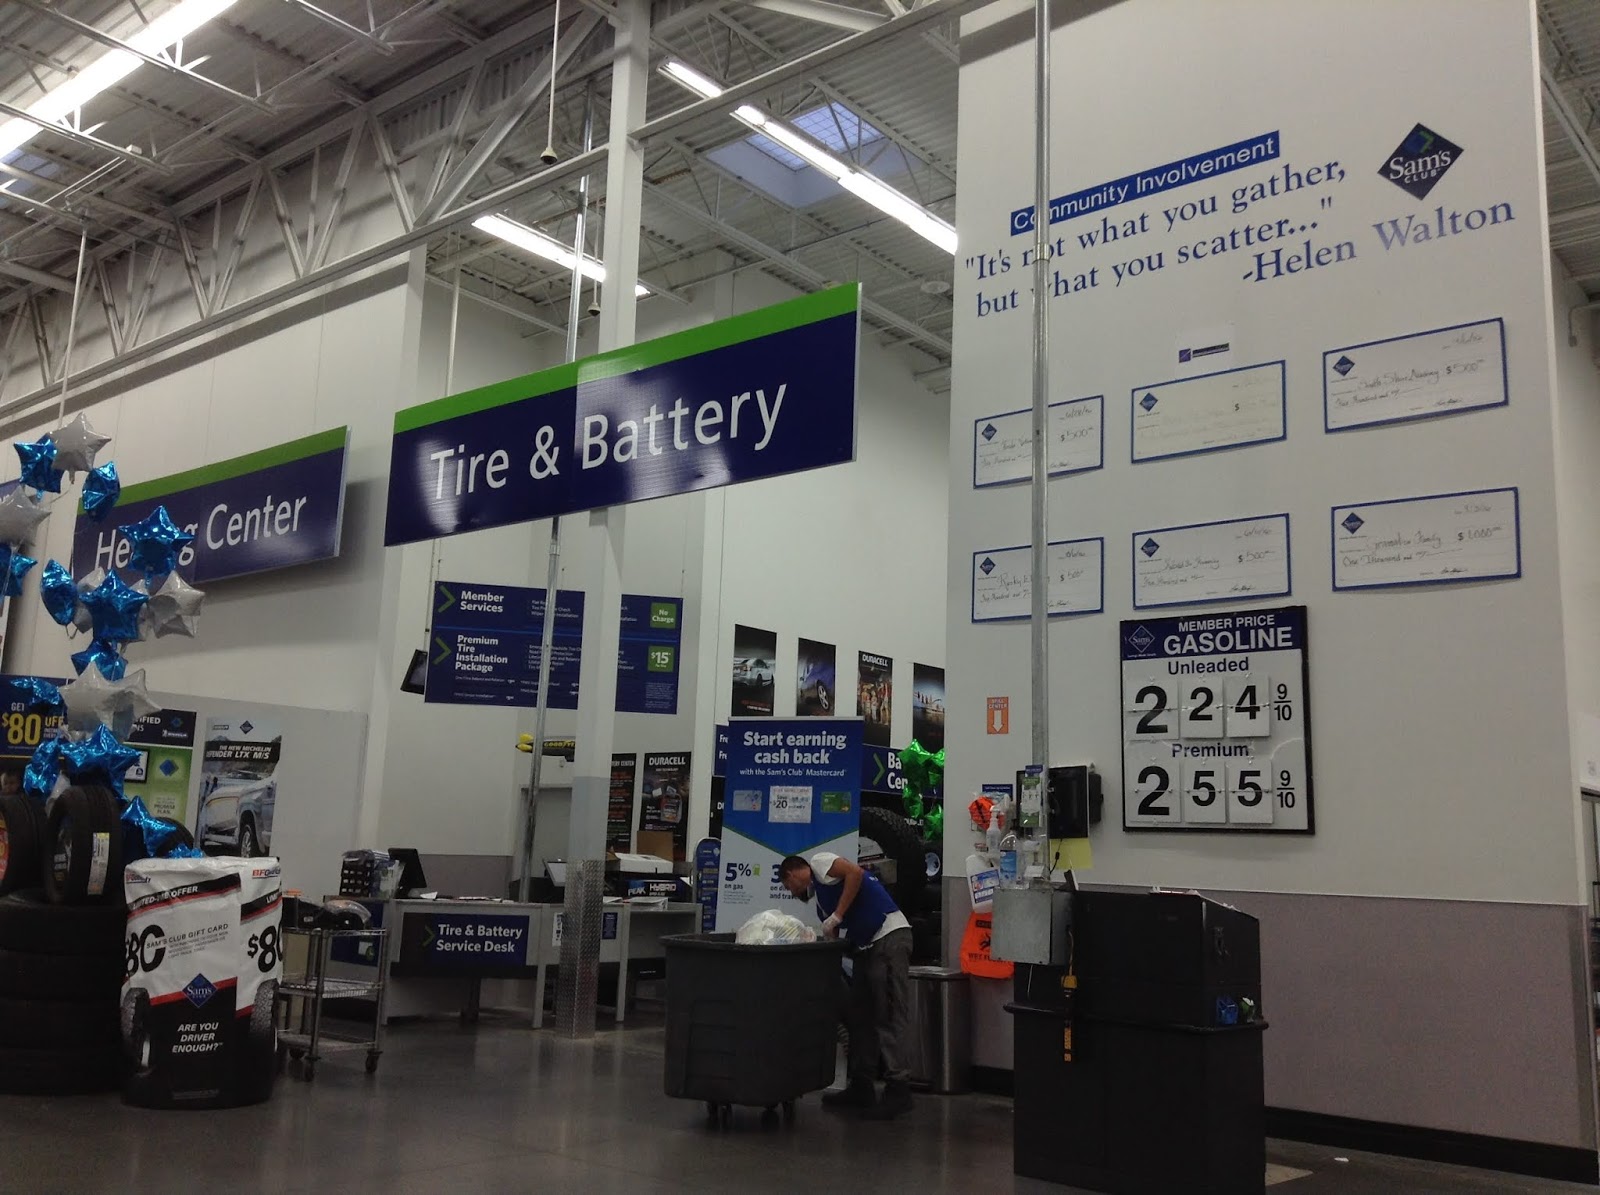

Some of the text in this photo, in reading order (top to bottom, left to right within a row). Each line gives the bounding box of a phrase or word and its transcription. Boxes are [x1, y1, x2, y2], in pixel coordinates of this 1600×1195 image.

[1136, 137, 1275, 193] Involvement
[1388, 150, 1452, 180] Sam's
[1404, 169, 1438, 184] CLUB
[1077, 212, 1150, 250] what
[1163, 195, 1218, 232] you
[1231, 161, 1345, 214] gather,
[1242, 201, 1516, 283] -Helen Walton
[976, 288, 1019, 318] but
[1030, 266, 1099, 298] hat
[1111, 251, 1166, 287] you
[430, 383, 787, 500] Tire & Battery
[206, 494, 307, 550] Center
[461, 590, 504, 602] Member
[460, 601, 503, 613] Services
[1178, 615, 1275, 632] MEMBER PRICE
[457, 634, 499, 646] Premium
[1163, 626, 1293, 656] GASOLINE
[457, 643, 476, 653] Tire
[456, 653, 508, 664] Installation
[862, 653, 888, 667] DURACELL
[1168, 656, 1250, 675] Unleaded
[455, 662, 493, 673] Package
[2, 712, 42, 746] $80
[743, 730, 847, 750] Start earning
[234, 750, 250, 758] LTX
[252, 751, 270, 760] M/S
[754, 749, 830, 764] cash back
[1171, 742, 1250, 758] Premium
[649, 756, 686, 766] DURACELL
[766, 768, 786, 776] Sam's
[787, 768, 803, 776] Club
[806, 769, 845, 777] Mastercard
[724, 862, 752, 882] 5%
[170, 885, 199, 898] OFFER
[627, 883, 677, 897] PEAK HYBRID
[146, 939, 168, 949] SAM'S
[168, 933, 186, 943] CLUB
[188, 928, 206, 938] GIFT
[207, 923, 229, 934] CARD
[438, 923, 523, 940] Tire & Battery
[436, 939, 516, 953] Service Desk
[177, 1022, 219, 1032] ARE YOU
[180, 1033, 216, 1042] DRIVER
